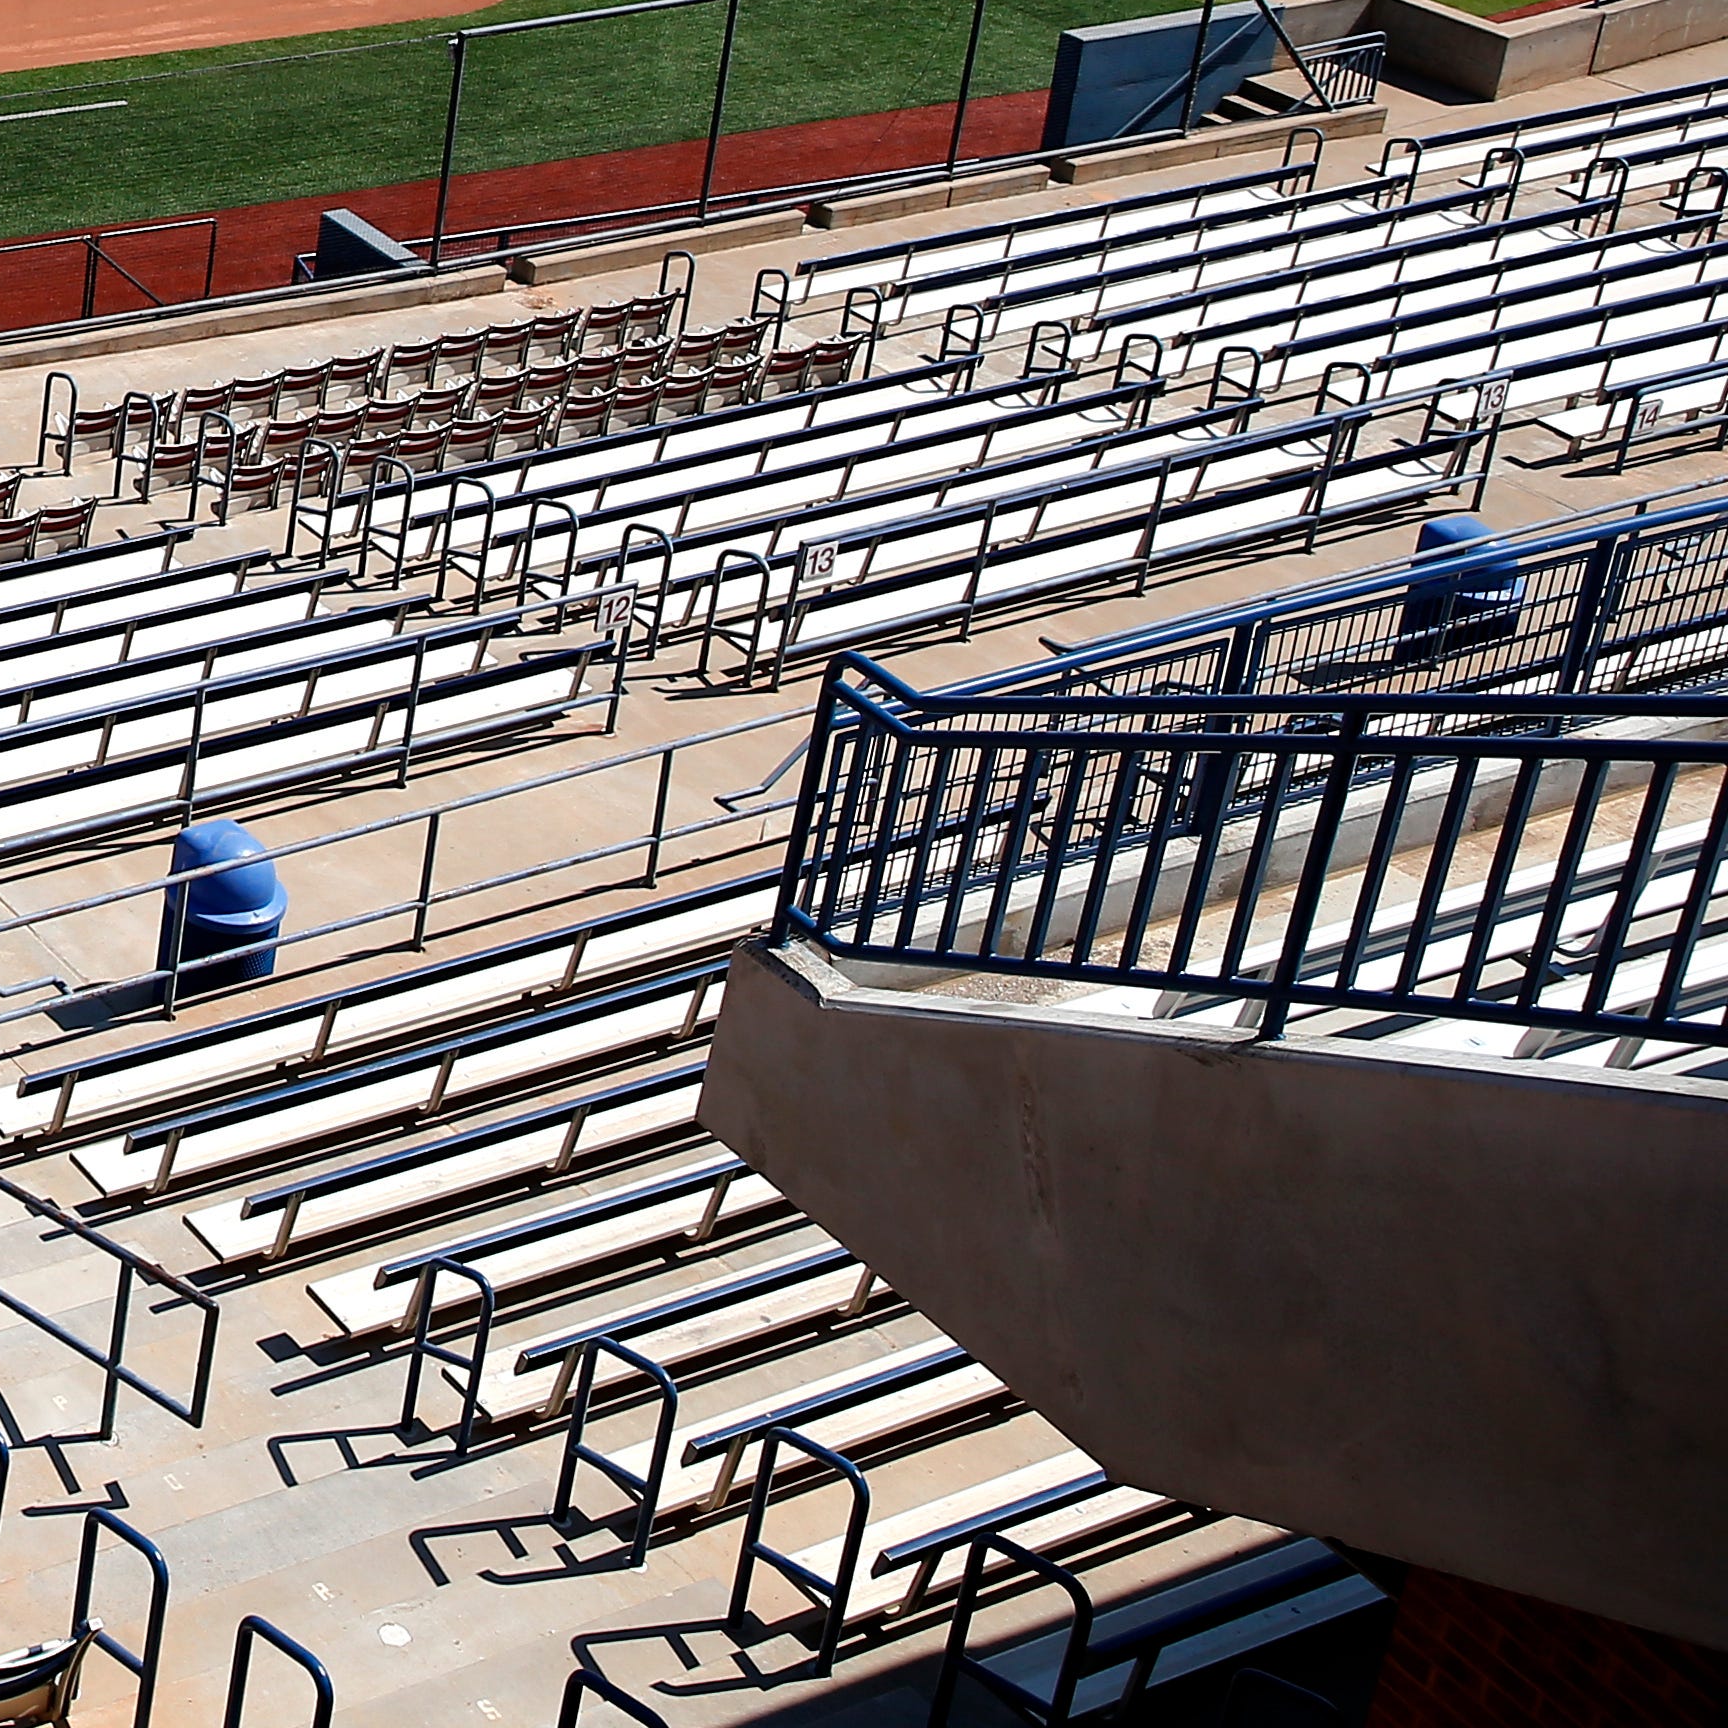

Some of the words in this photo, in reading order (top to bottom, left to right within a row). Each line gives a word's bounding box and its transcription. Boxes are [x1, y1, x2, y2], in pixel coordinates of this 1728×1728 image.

[1483, 384, 1506, 409] 13
[1637, 405, 1661, 425] 14
[807, 546, 835, 575] 13
[602, 595, 632, 624] 12
[51, 1394, 69, 1412] P
[311, 1582, 335, 1602] R
[475, 1698, 502, 1721] S
